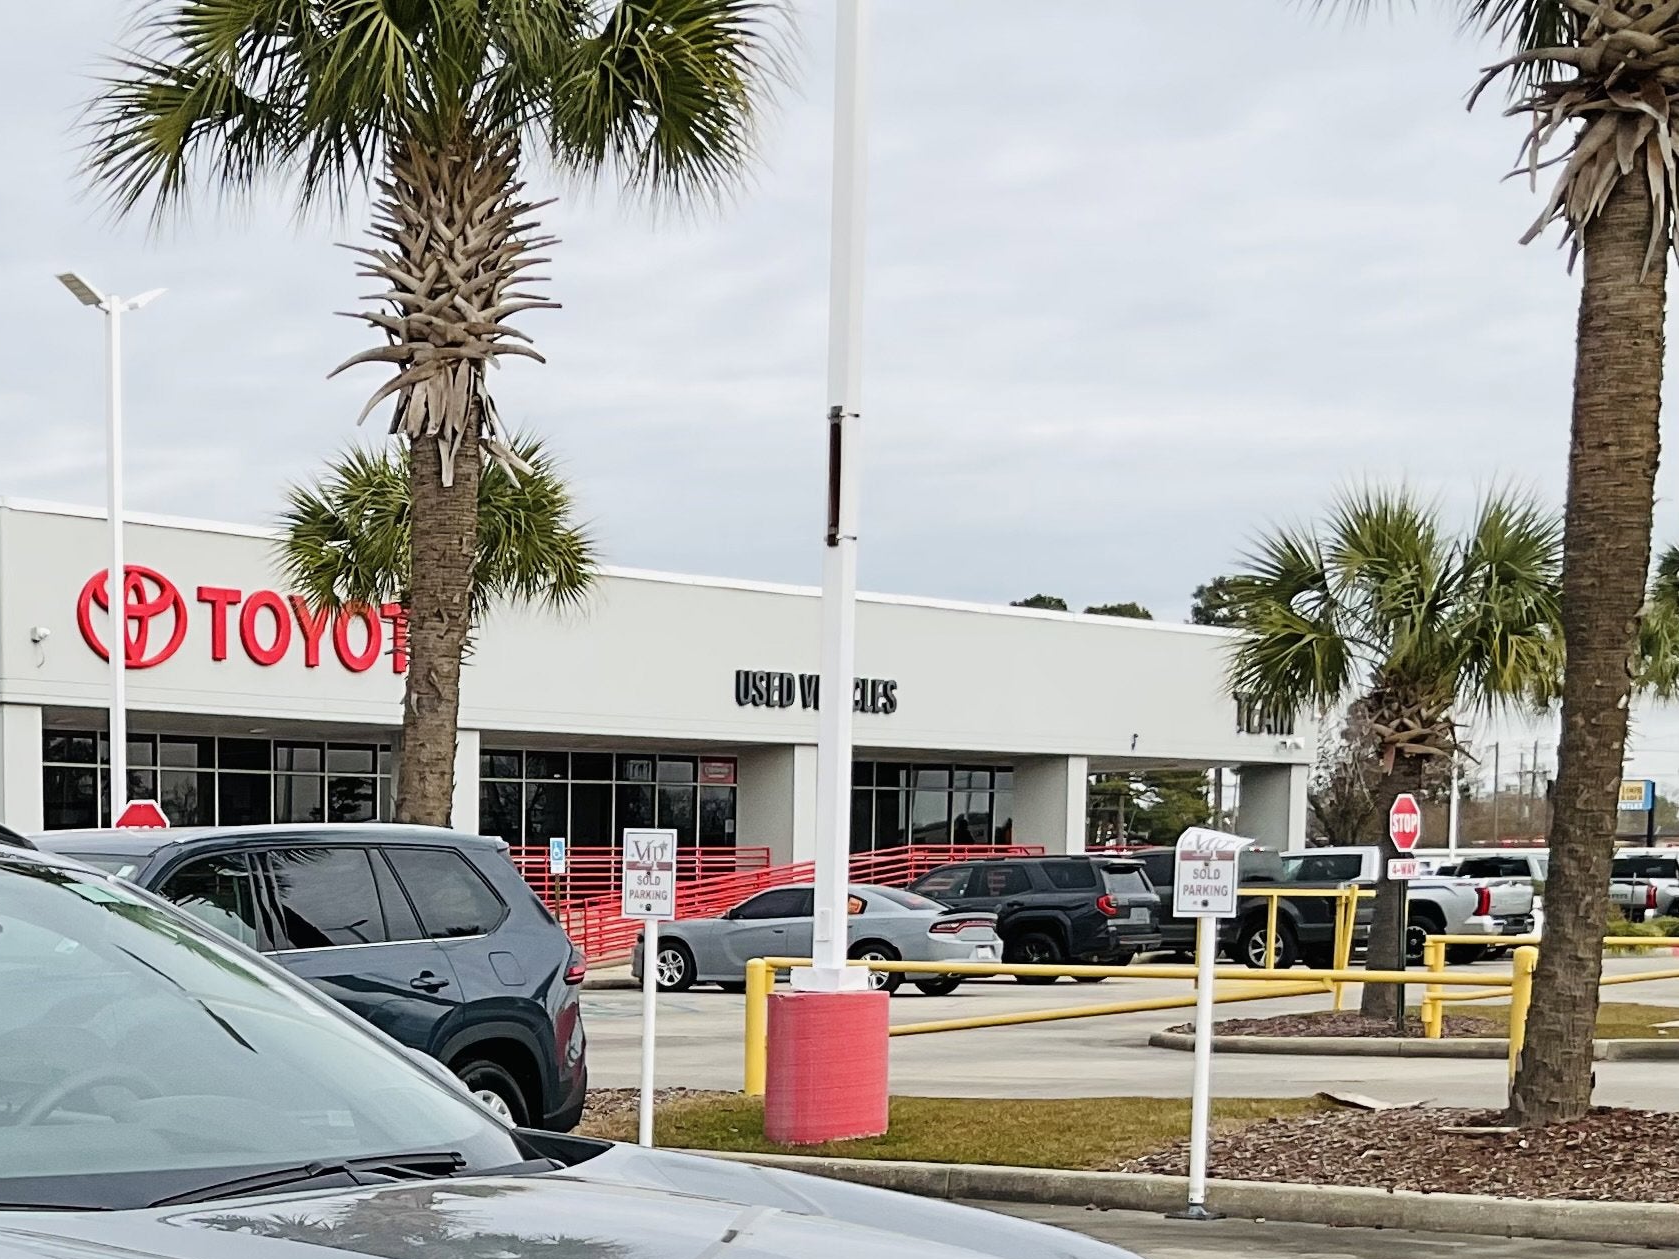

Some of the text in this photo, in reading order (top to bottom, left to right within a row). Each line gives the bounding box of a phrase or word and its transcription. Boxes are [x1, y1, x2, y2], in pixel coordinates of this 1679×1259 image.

[197, 586, 411, 674] TOYOT
[735, 670, 898, 714] USED VCLES
[1392, 813, 1417, 833] STOP
[1192, 868, 1221, 880] SOLD
[1392, 863, 1416, 874] 4-WAY
[636, 875, 661, 886] SOLD
[629, 889, 668, 900] PARKING
[1182, 884, 1228, 897] PARKING
